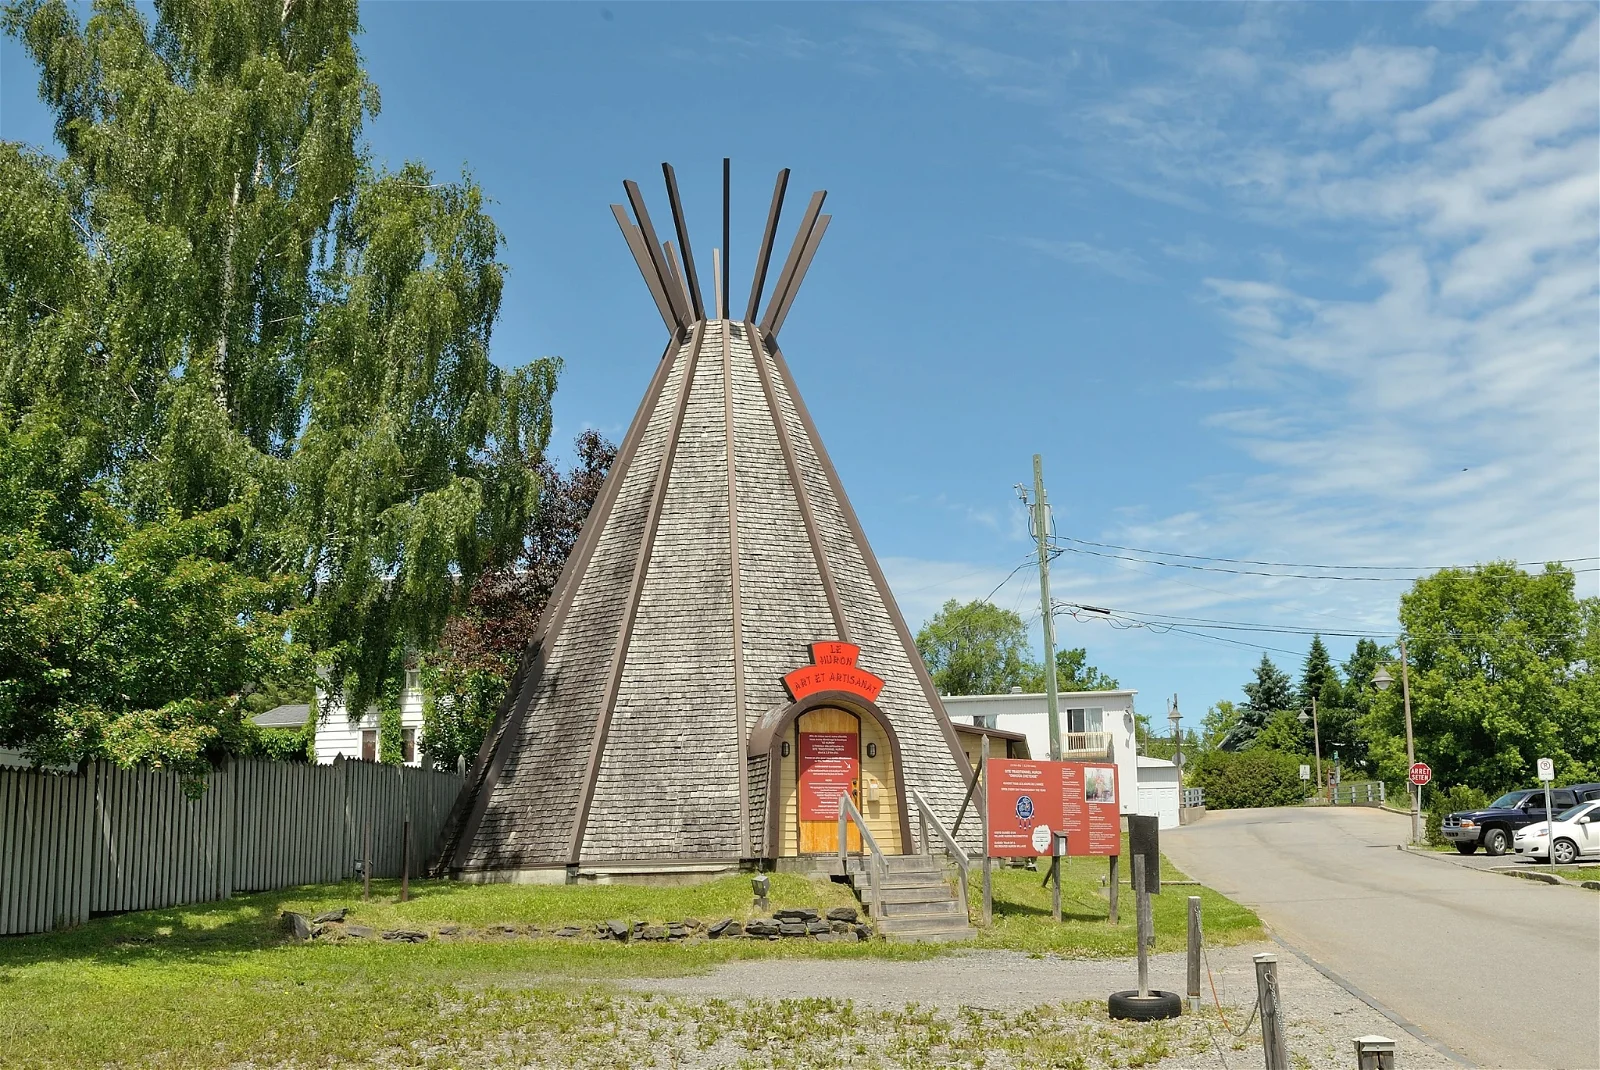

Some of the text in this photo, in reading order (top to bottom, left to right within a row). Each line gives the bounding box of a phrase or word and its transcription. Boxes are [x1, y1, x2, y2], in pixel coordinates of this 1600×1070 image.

[830, 644, 842, 654] LE
[819, 655, 853, 666] HURON
[794, 672, 877, 694] ART ET ARTISANAT
